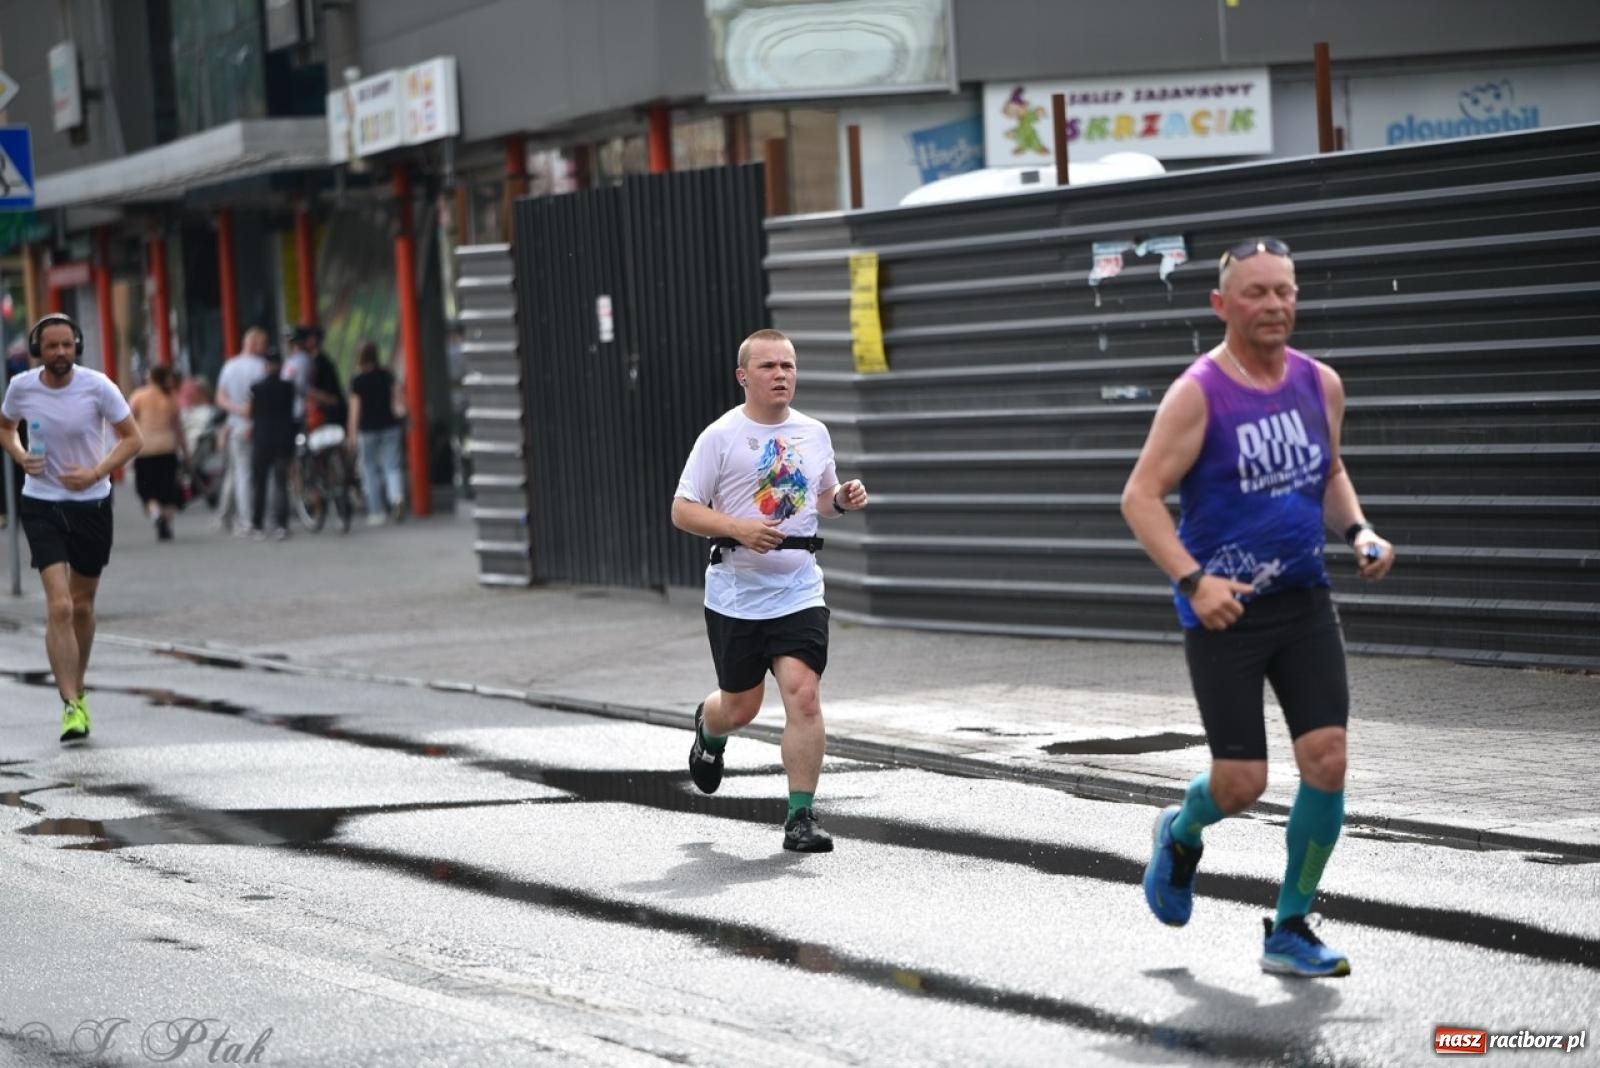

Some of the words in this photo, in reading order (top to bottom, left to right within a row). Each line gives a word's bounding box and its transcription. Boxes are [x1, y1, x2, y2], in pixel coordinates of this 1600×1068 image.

[1069, 90, 1123, 106] SKLEP
[1065, 106, 1255, 141] SKRZACIK
[1236, 409, 1310, 477] RUN
